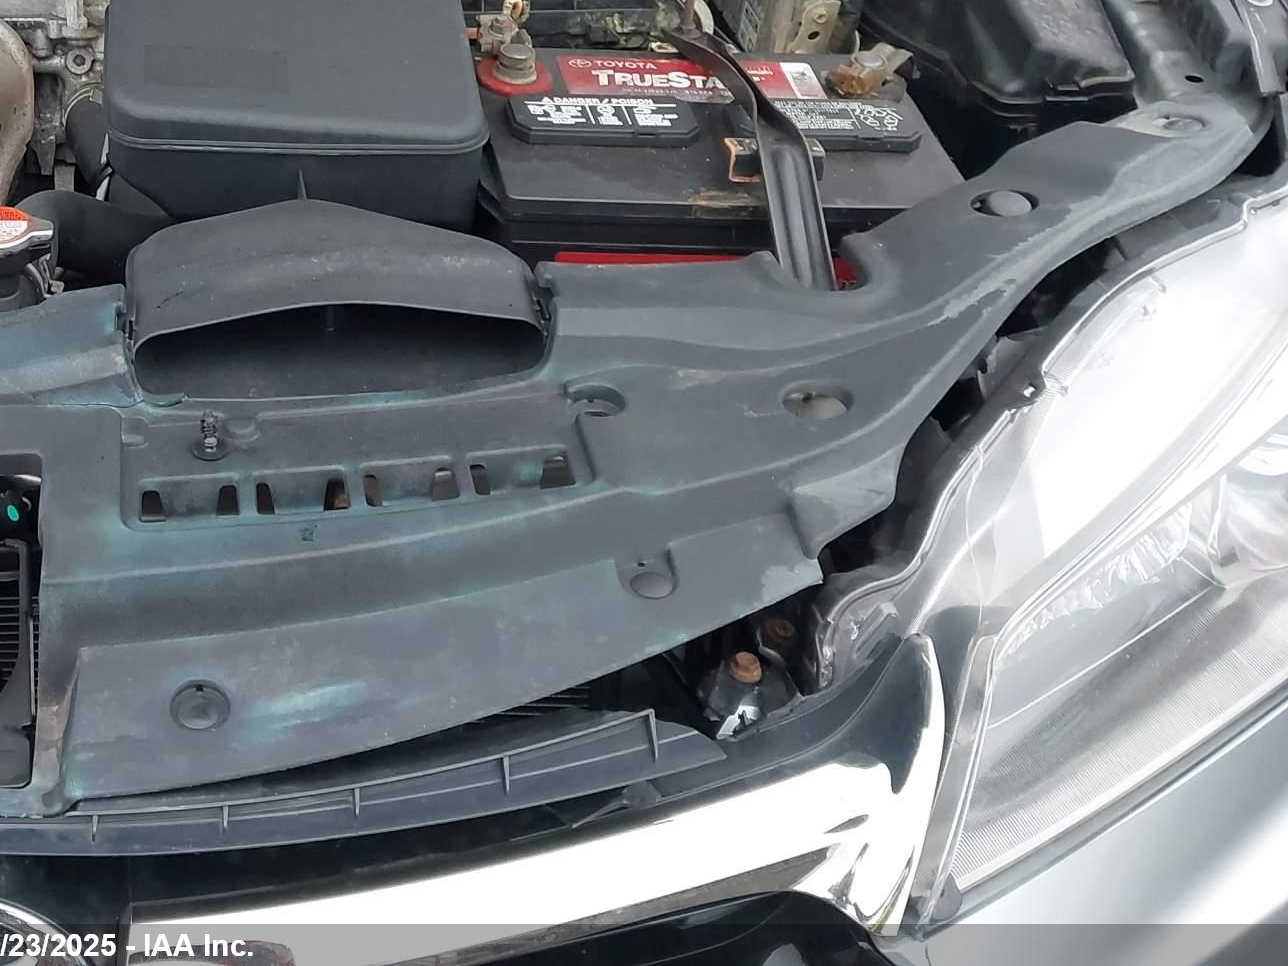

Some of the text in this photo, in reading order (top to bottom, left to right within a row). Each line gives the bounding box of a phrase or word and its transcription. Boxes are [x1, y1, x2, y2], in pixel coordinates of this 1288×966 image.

[593, 59, 657, 70] TOYOTA
[591, 69, 728, 90] TRUESTA
[552, 96, 600, 105] DANGER
[610, 97, 654, 106] POISON
